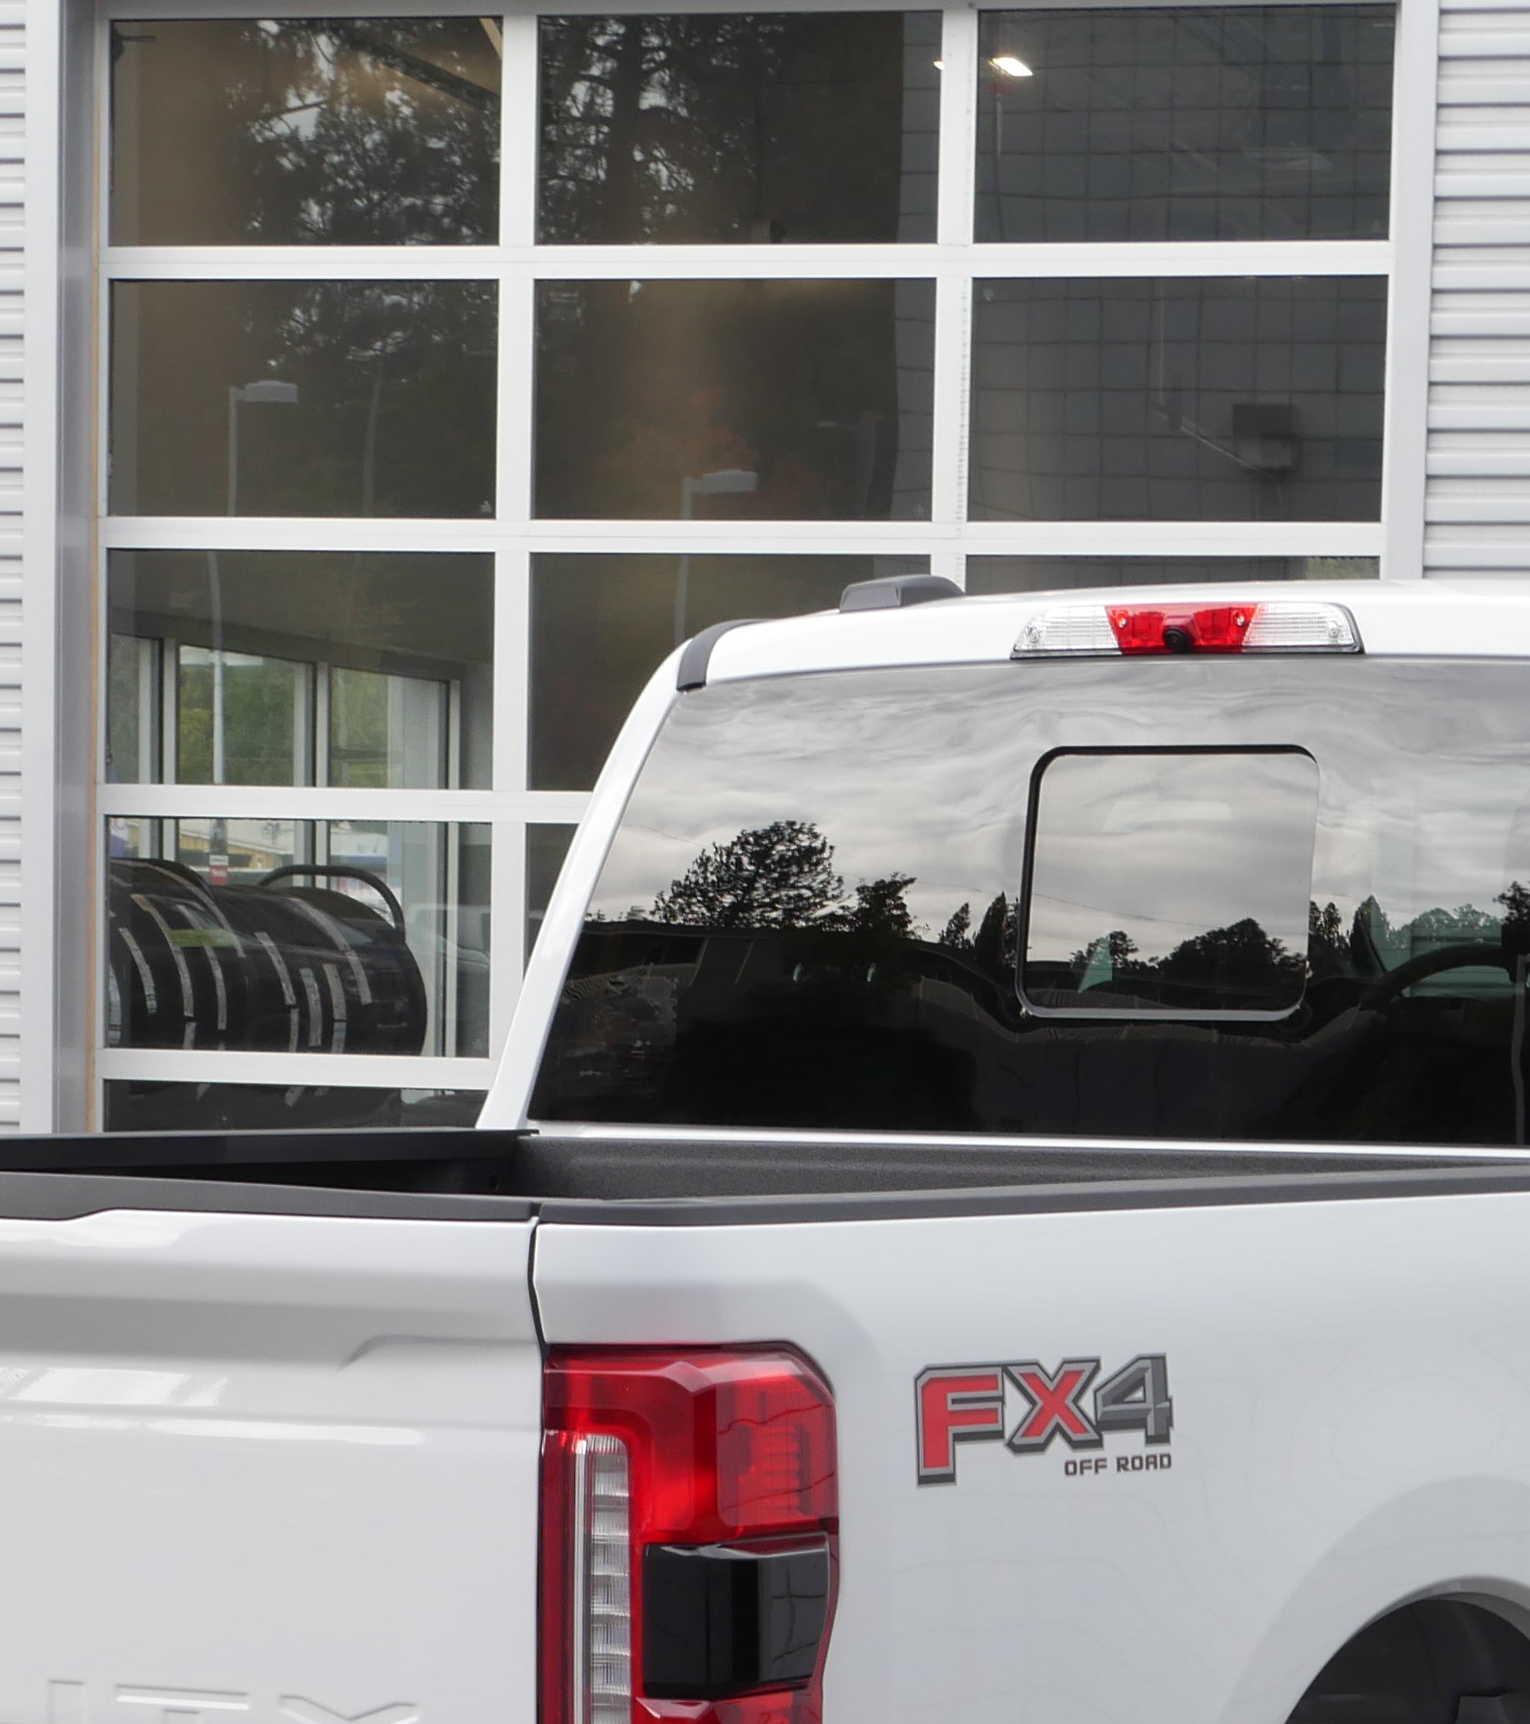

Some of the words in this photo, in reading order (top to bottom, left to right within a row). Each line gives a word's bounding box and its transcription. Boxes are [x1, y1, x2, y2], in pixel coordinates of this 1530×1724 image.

[914, 1352, 1174, 1488] FX4
[1064, 1457, 1108, 1477] OFF
[1116, 1453, 1173, 1474] ROAD
